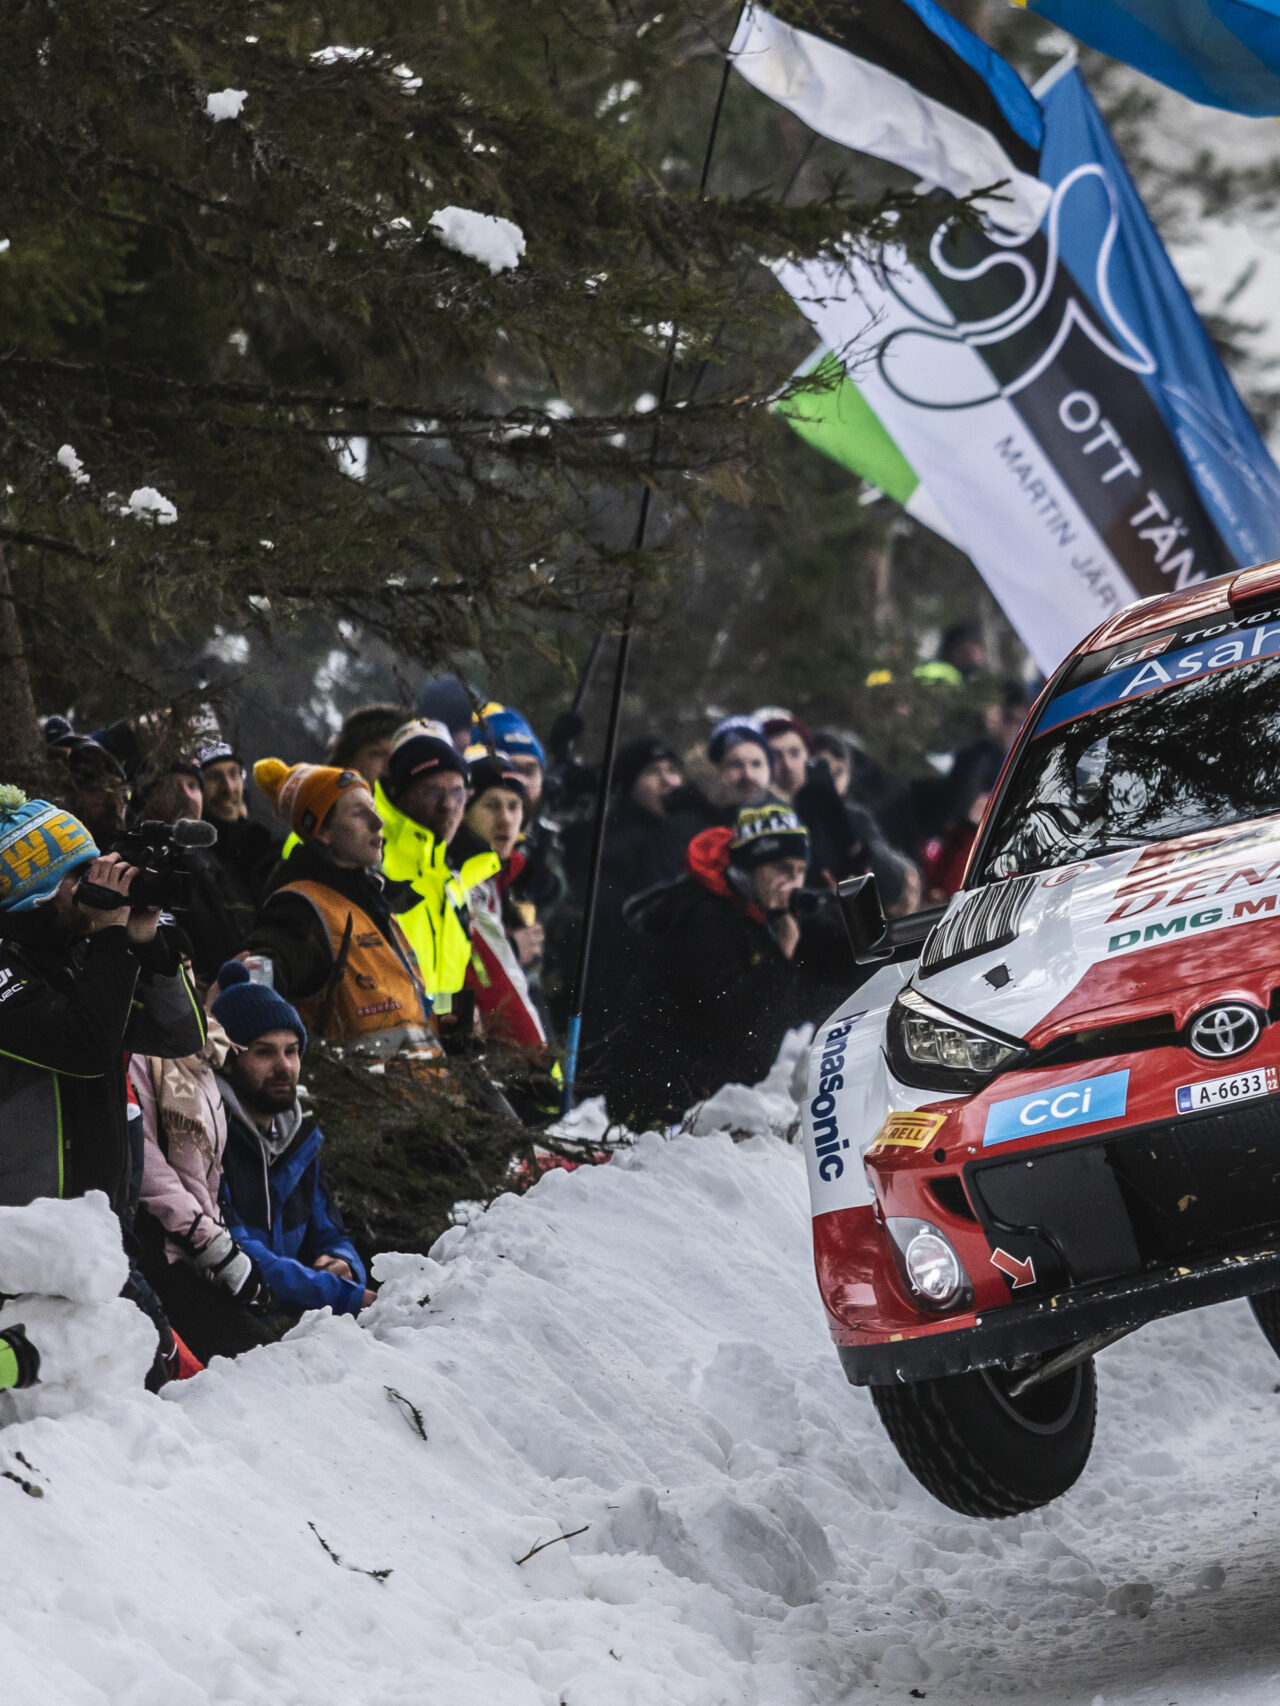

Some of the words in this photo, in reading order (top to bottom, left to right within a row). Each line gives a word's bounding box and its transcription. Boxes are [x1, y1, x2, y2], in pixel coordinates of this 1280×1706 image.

[1058, 390, 1142, 484] OTT
[994, 433, 1077, 547] MARTIN
[1107, 639, 1170, 671] GR
[1107, 907, 1222, 952] DMG
[1200, 1075, 1261, 1104] A-6633
[1266, 1067, 1276, 1077] 11
[1267, 1079, 1278, 1090] 22
[811, 1009, 869, 1182] Panasonic
